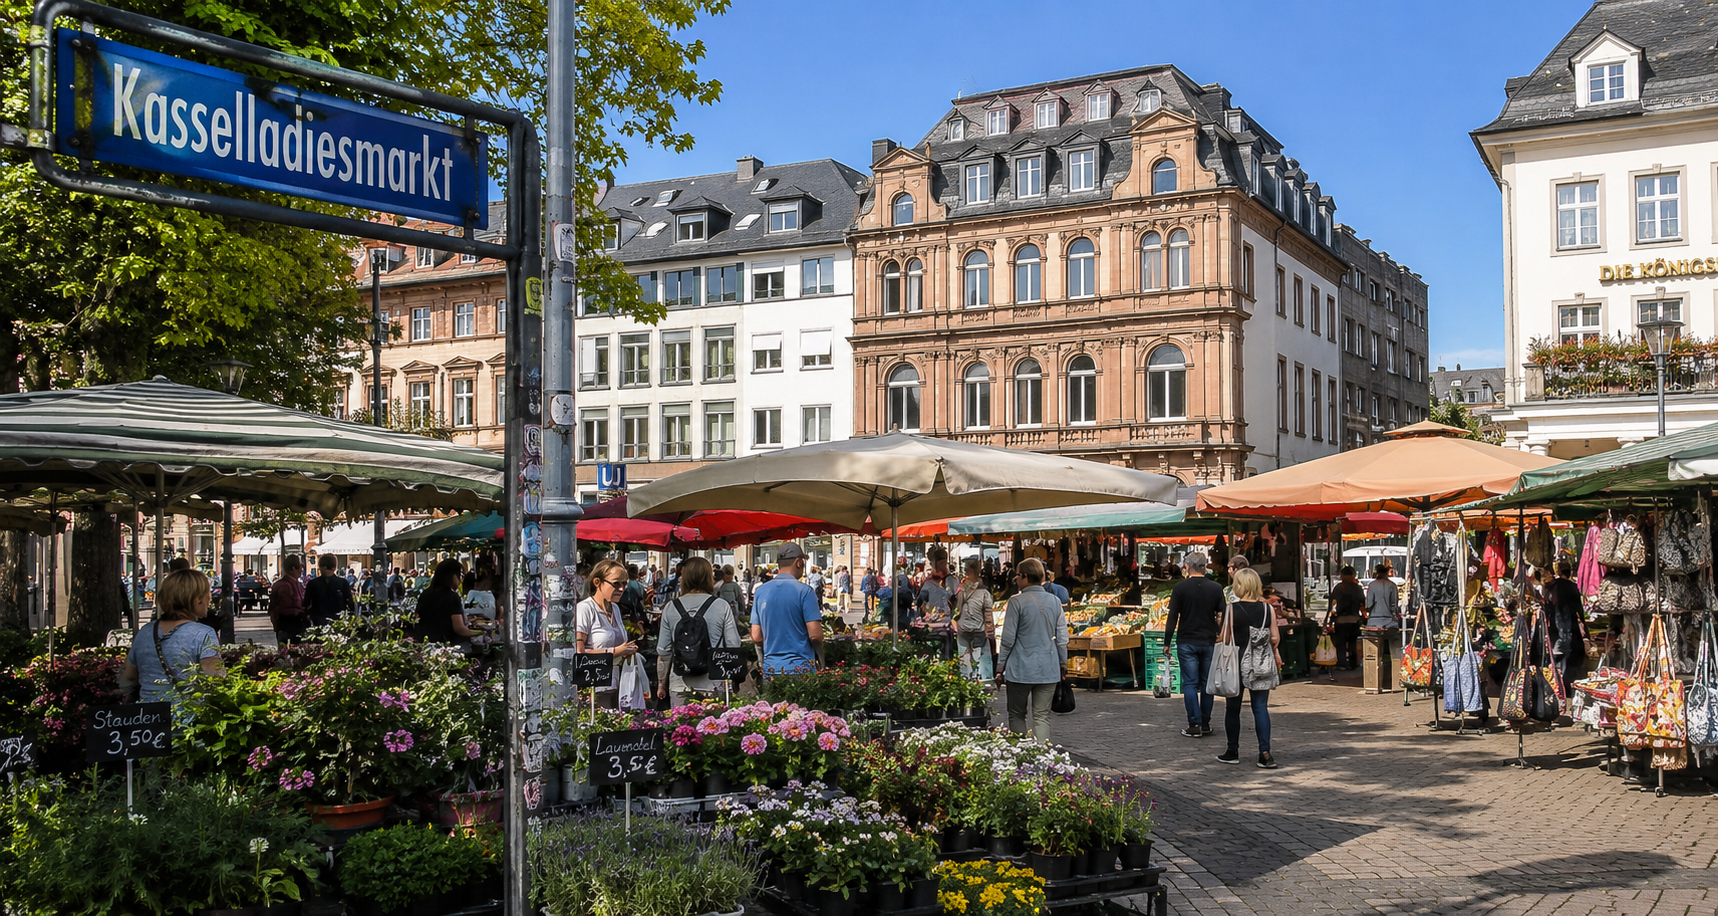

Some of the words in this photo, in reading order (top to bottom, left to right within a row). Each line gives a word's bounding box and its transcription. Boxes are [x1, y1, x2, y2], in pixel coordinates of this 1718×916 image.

[113, 63, 453, 201] Kasselladiesmarkt
[1599, 263, 1633, 281] DIE
[1639, 257, 1718, 278] KÖNIGS
[602, 466, 613, 487] U
[106, 729, 166, 756] 3,50€
